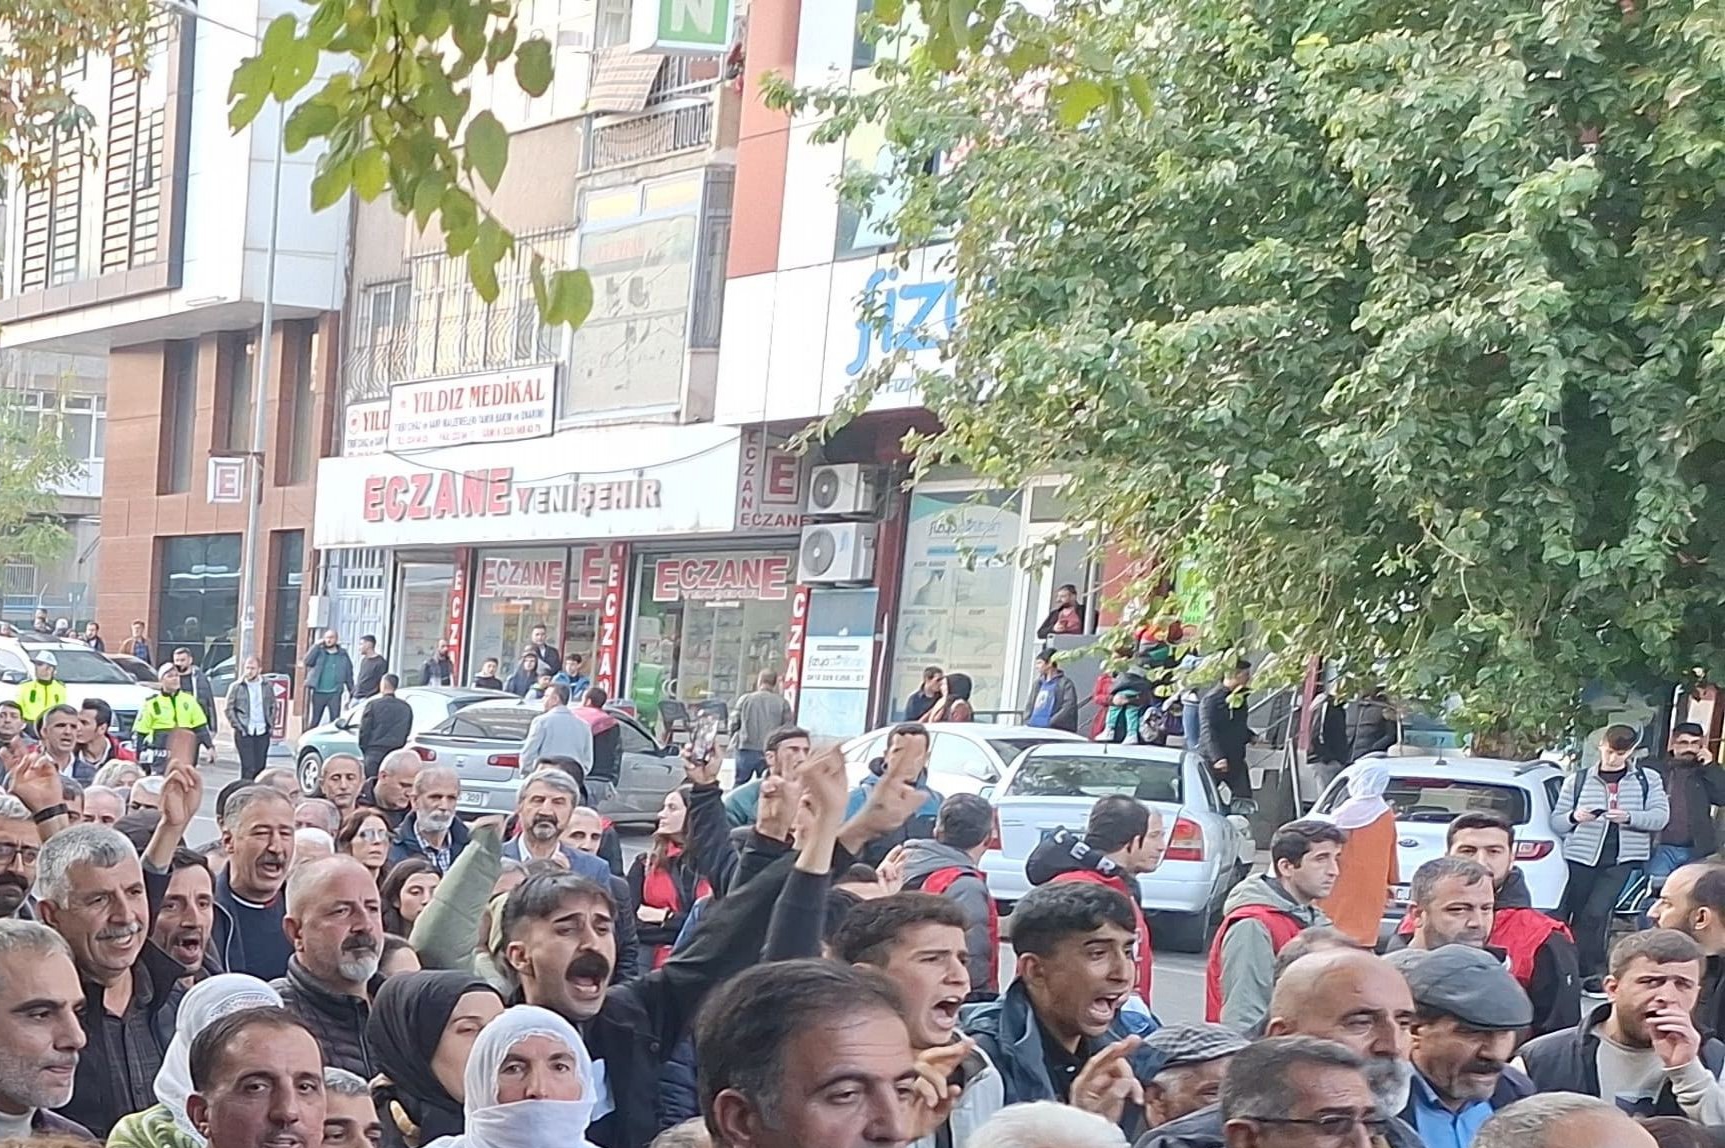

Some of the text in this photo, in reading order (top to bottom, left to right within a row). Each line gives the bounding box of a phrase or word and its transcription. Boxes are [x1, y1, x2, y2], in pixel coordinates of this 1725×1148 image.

[670, 0, 715, 35] N
[414, 375, 545, 414] YILDIZ MEDİKAL
[219, 469, 236, 494] E
[363, 467, 662, 522] ECZANE YENİŞEHİR
[769, 456, 796, 495] E
[740, 511, 812, 527] ECZANE
[479, 557, 563, 599] ECZANE
[578, 548, 604, 601] E
[653, 555, 790, 602] ECZANE
